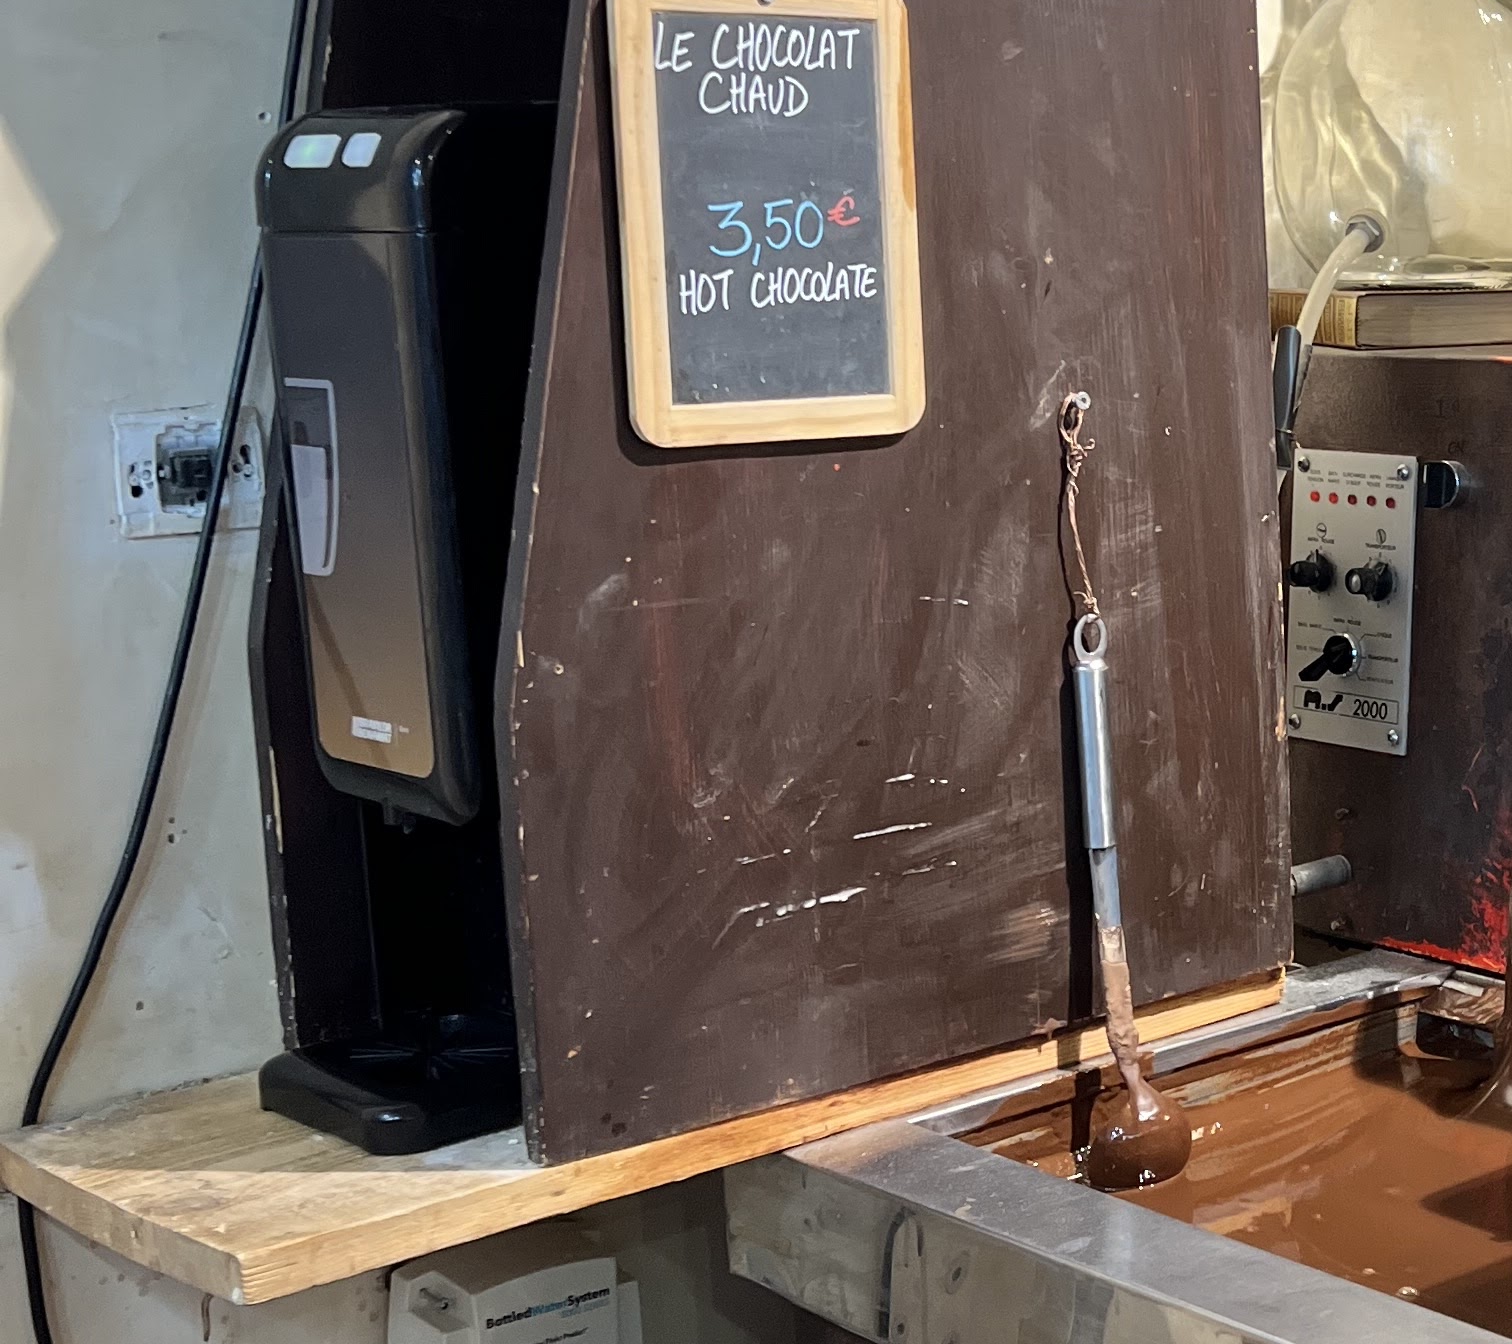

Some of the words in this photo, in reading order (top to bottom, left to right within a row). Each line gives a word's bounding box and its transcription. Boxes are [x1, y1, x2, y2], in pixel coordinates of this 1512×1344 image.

[653, 21, 695, 73] LE
[711, 22, 861, 72] CHOCOLAT
[699, 72, 810, 118] CHAUD
[679, 268, 734, 316] HOT
[750, 261, 879, 310] CHOCOLATE
[1353, 698, 1388, 720] 2000
